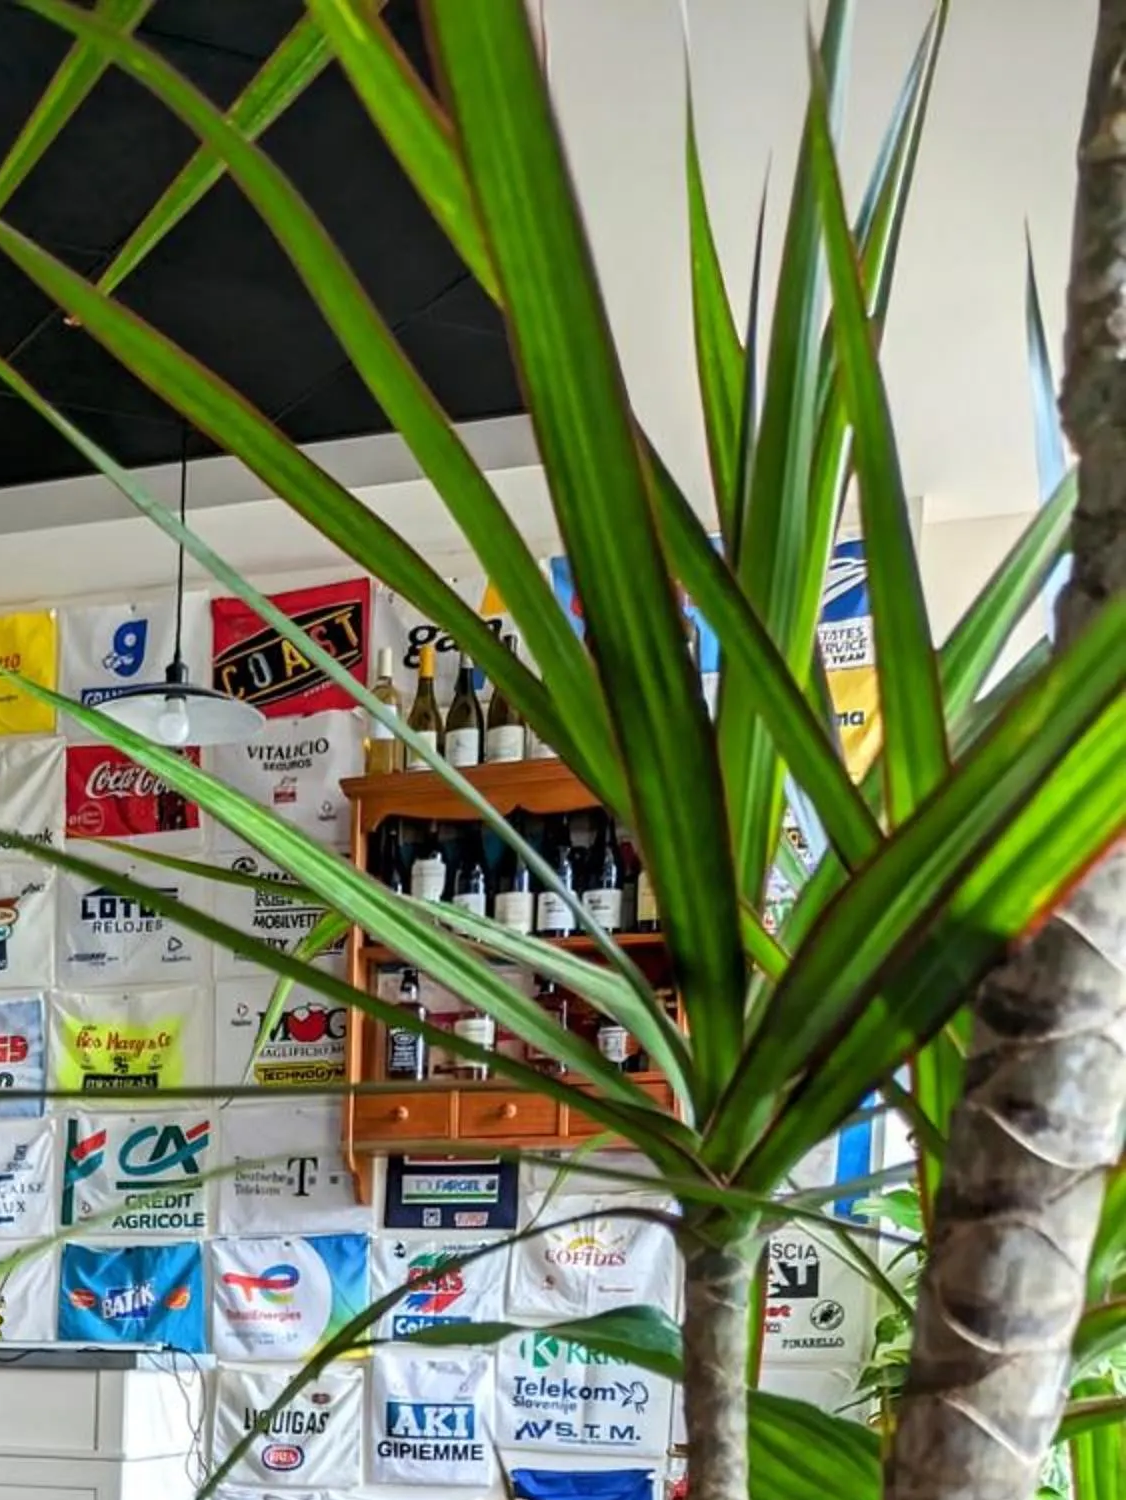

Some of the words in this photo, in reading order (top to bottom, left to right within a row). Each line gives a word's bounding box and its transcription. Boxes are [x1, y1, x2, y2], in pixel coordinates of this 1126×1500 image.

[247, 738, 329, 761] VITALICIO
[82, 898, 165, 920] LOTU
[93, 920, 163, 934] RELOJES
[254, 913, 317, 929] MOBILVETT
[112, 1212, 205, 1229] AGRICOLE
[514, 1376, 616, 1401] Telekom
[513, 1396, 577, 1415] Slovenije
[390, 1405, 470, 1438] AKI
[377, 1441, 484, 1462] GIPIEMME
